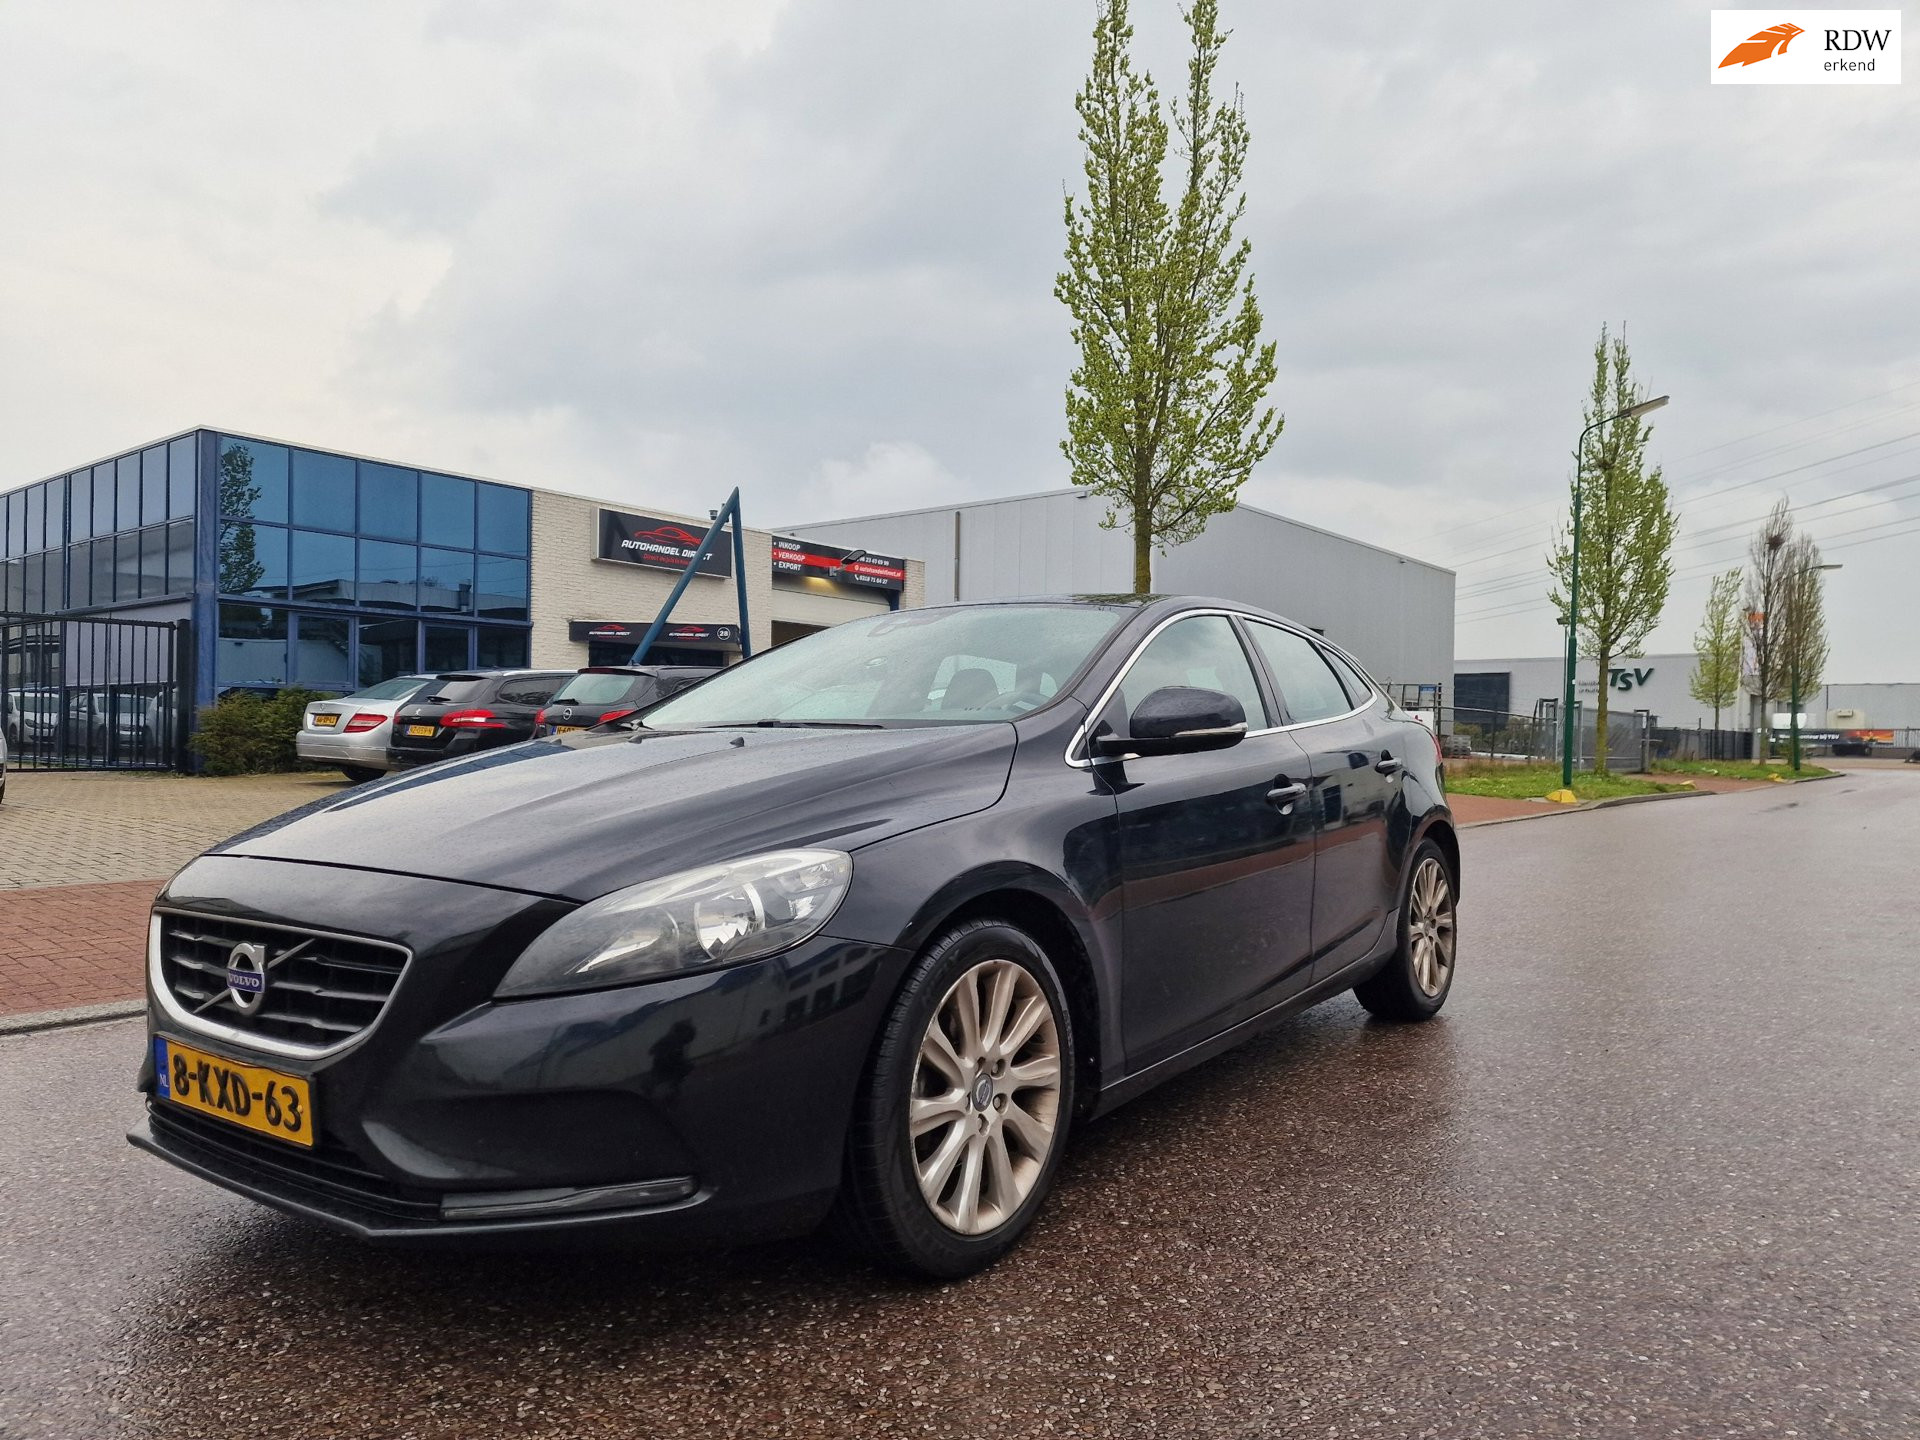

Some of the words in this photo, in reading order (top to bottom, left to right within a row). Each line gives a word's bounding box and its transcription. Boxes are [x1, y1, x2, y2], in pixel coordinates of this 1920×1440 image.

[621, 539, 680, 556] AUTOHANDEL
[778, 541, 801, 551] INKOOP
[778, 552, 806, 562] VERKOOP
[778, 562, 802, 571] EXPORT
[1608, 667, 1655, 691] TSV
[228, 972, 260, 988] VOLVO
[159, 1073, 170, 1088] NL
[172, 1053, 302, 1132] 8-KXD-63
